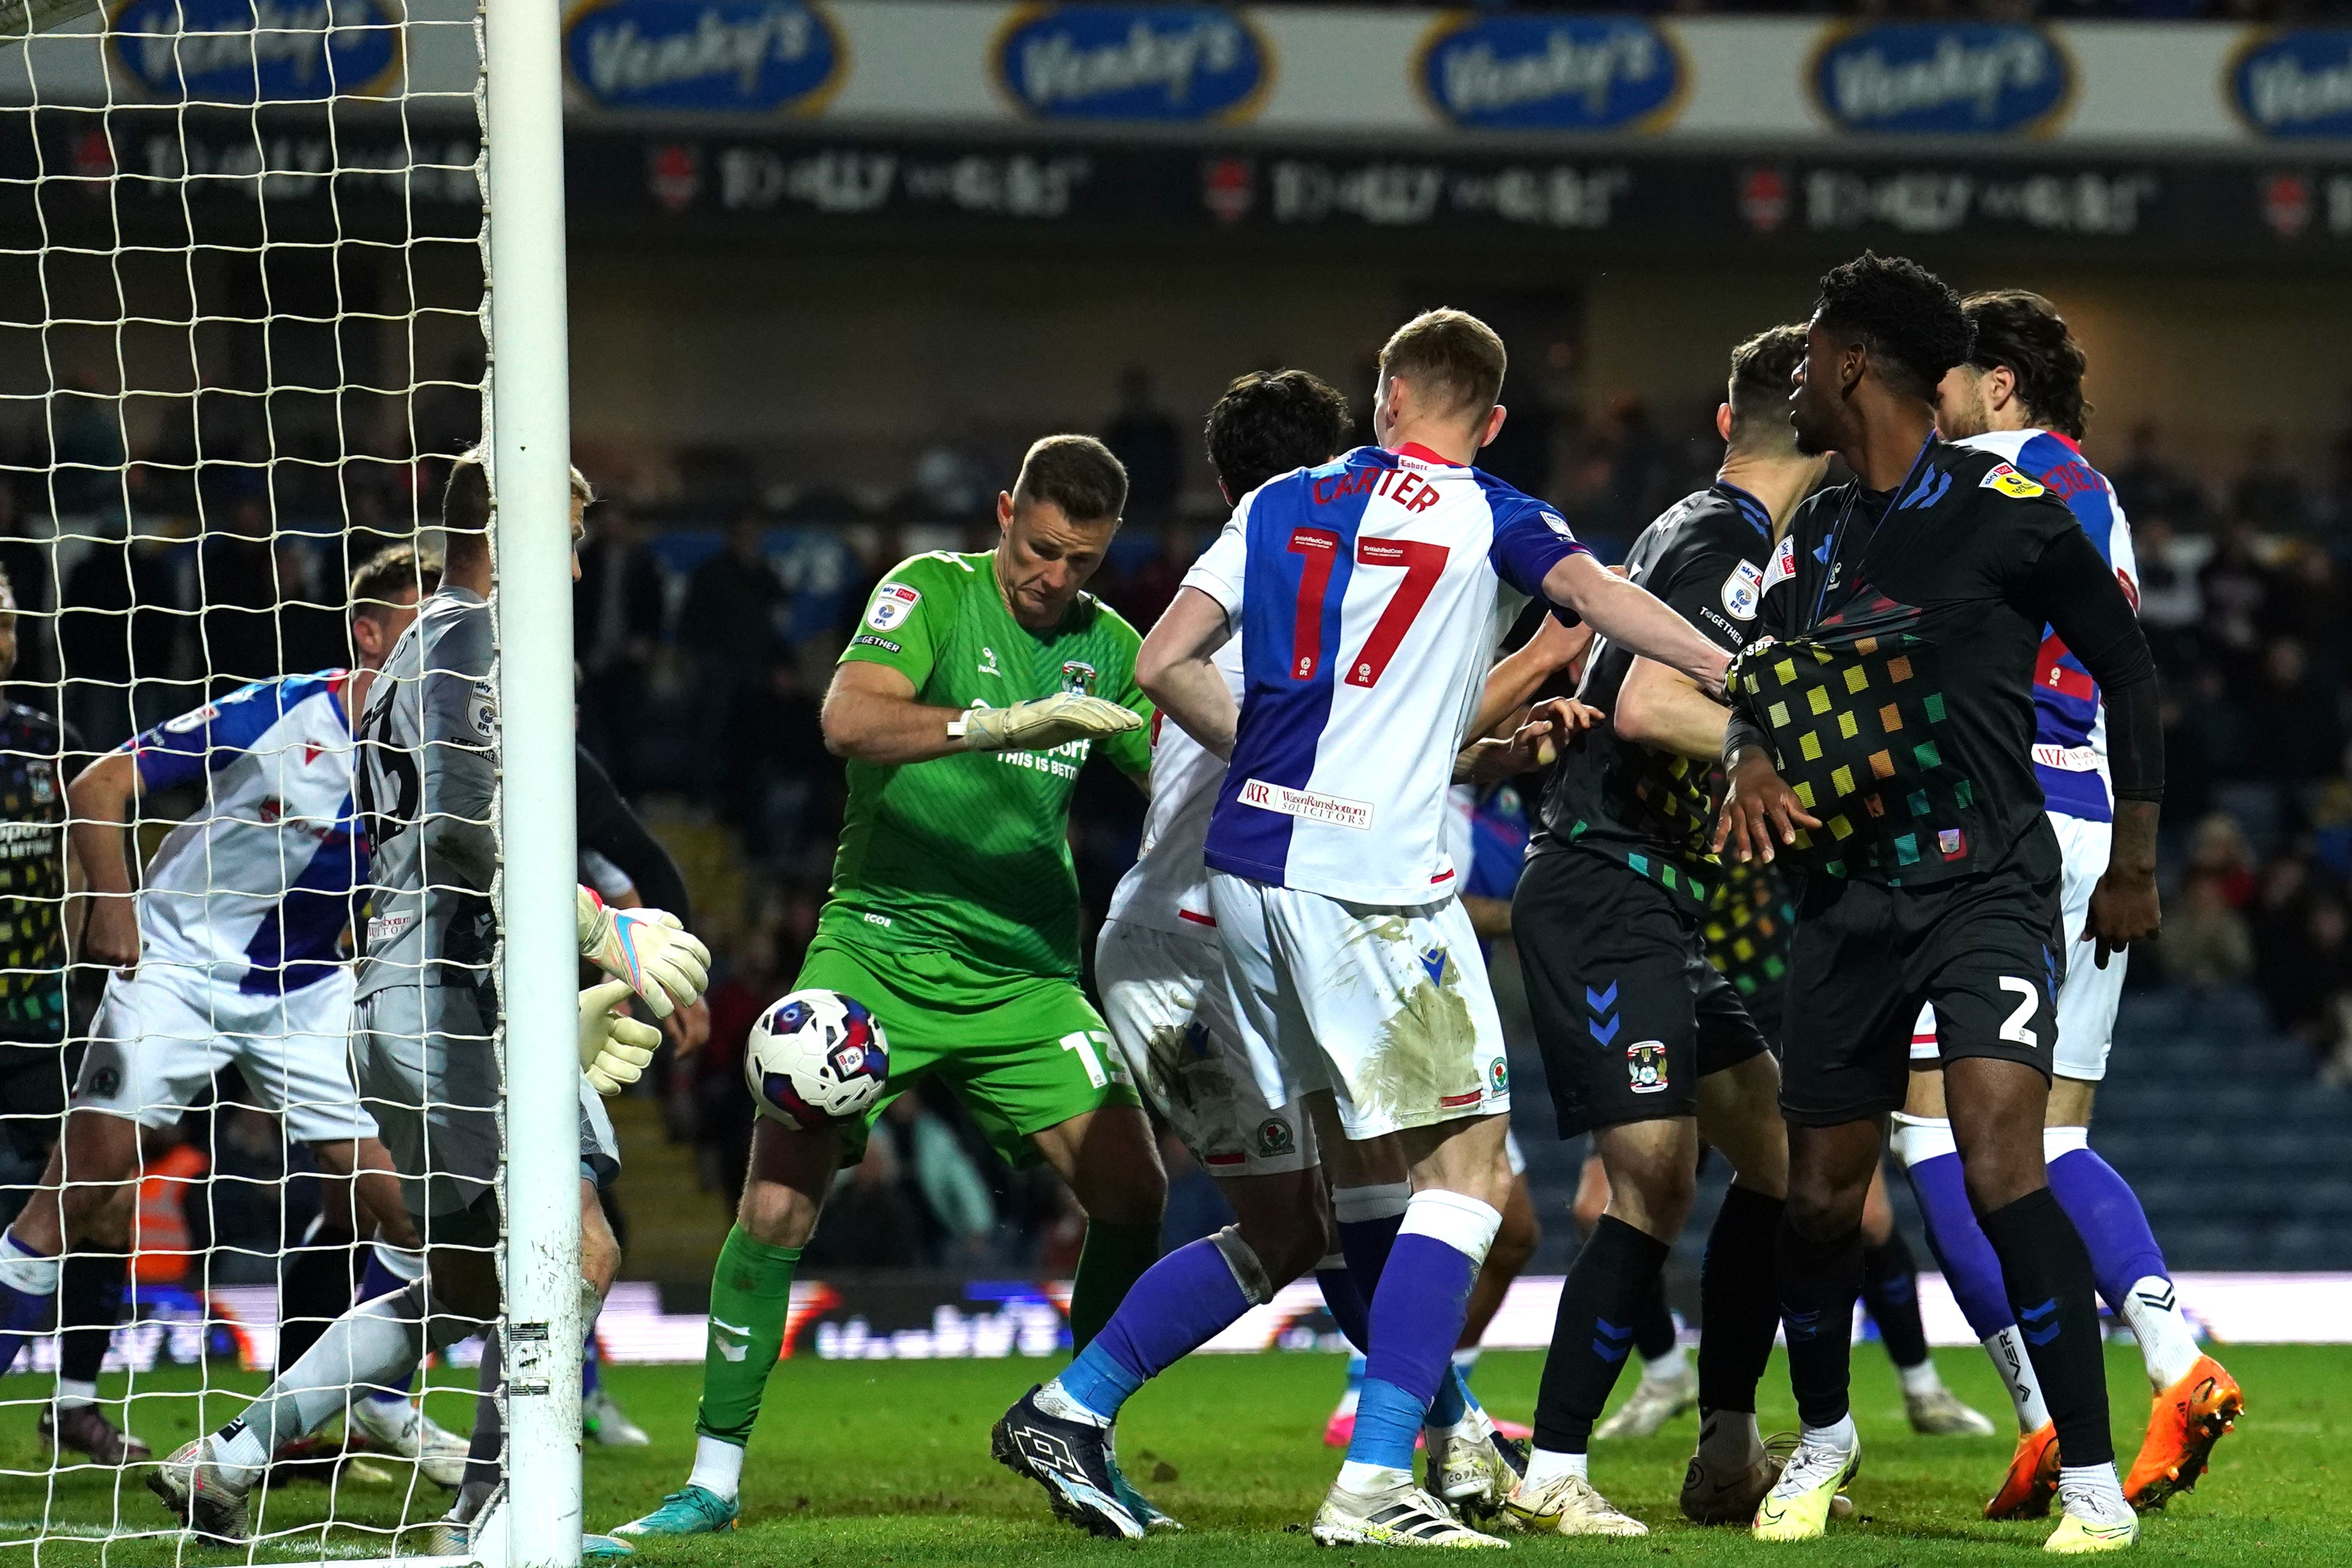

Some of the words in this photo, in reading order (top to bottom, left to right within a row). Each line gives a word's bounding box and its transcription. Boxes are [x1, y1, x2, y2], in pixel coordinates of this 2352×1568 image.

[588, 7, 810, 94] Venky's
[1023, 18, 1240, 107] Venky's
[1445, 25, 1657, 115] Venky's
[1833, 34, 2045, 119] Venky's
[1312, 467, 1441, 514] CARTER
[1781, 542, 1790, 556] sky
[1741, 566, 1756, 579] sky
[1785, 557, 1795, 573] bet
[1287, 527, 1450, 689] 17
[1730, 600, 1742, 614] EFL
[874, 618, 887, 626] EFL
[475, 682, 492, 693] sky
[477, 722, 490, 733] EFL
[1036, 756, 1049, 772] IS
[2038, 749, 2068, 767] WR
[1246, 782, 1270, 805] WR
[1282, 801, 1365, 825] SOLICITORS
[1998, 976, 2039, 1049] 2
[1058, 1030, 1136, 1089] 13
